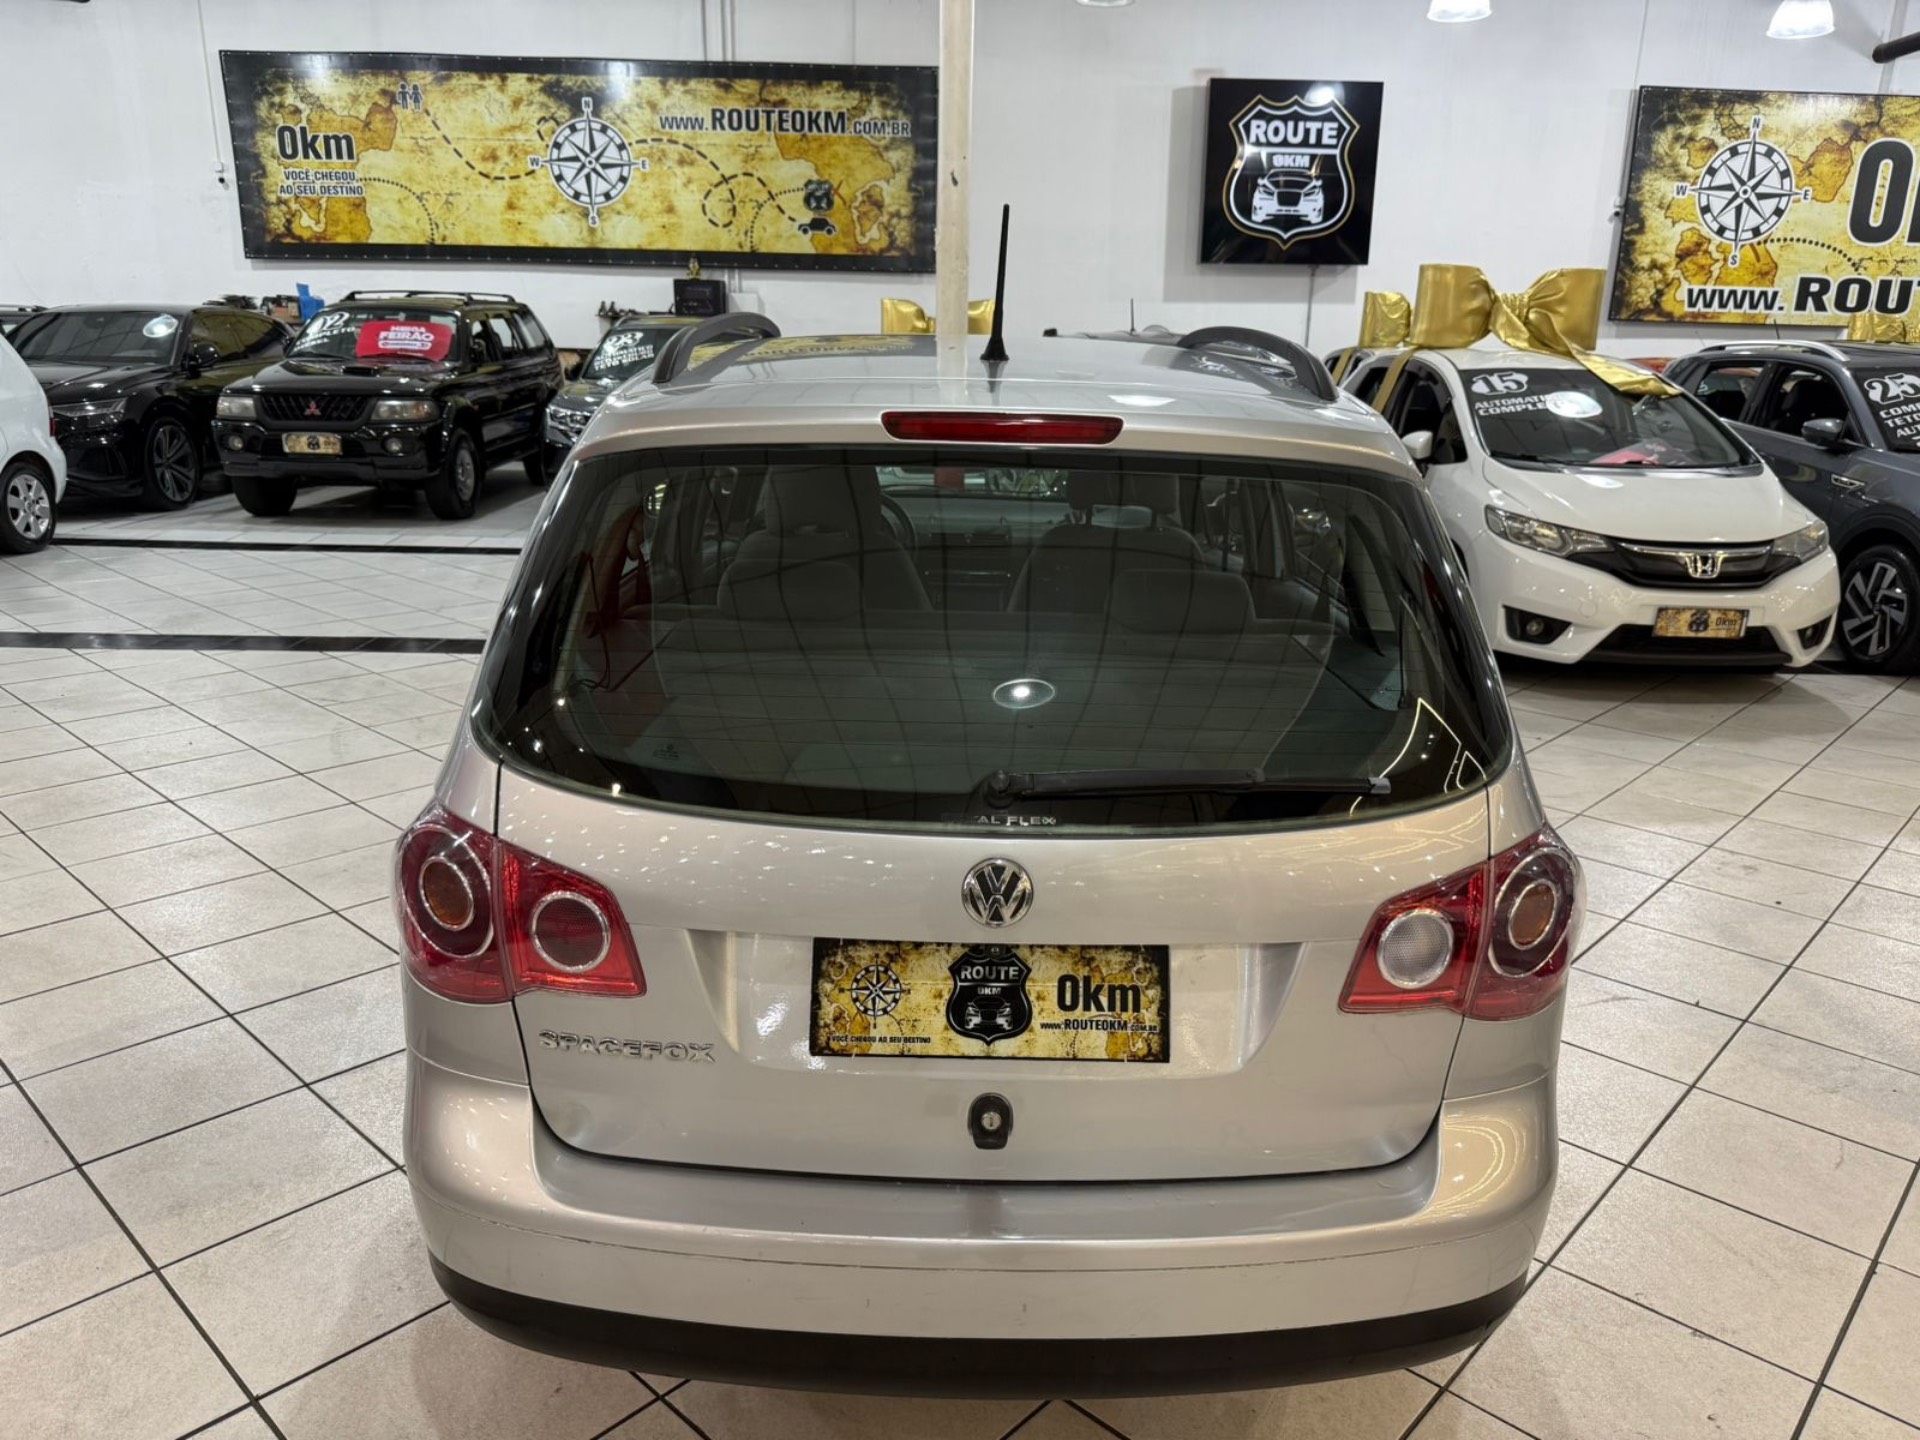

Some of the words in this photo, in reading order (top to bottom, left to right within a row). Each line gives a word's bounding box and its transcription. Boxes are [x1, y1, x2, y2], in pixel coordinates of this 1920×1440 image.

[1250, 119, 1339, 145] ROUTE
[284, 168, 310, 181] VOCÊ
[314, 170, 355, 182] CHEGOU
[280, 184, 293, 195] AO
[297, 185, 316, 195] SEU
[320, 185, 363, 196] DESTINO
[1849, 140, 1920, 243] 0
[1471, 371, 1528, 395] 15
[1864, 373, 1920, 405] 25
[1475, 394, 1548, 410] AUTOMATI
[1479, 402, 1547, 416] COMPLE
[1006, 816, 1056, 826] FLEX
[960, 966, 1020, 980] ROUTE
[538, 1029, 716, 1063] SPACEFOX
